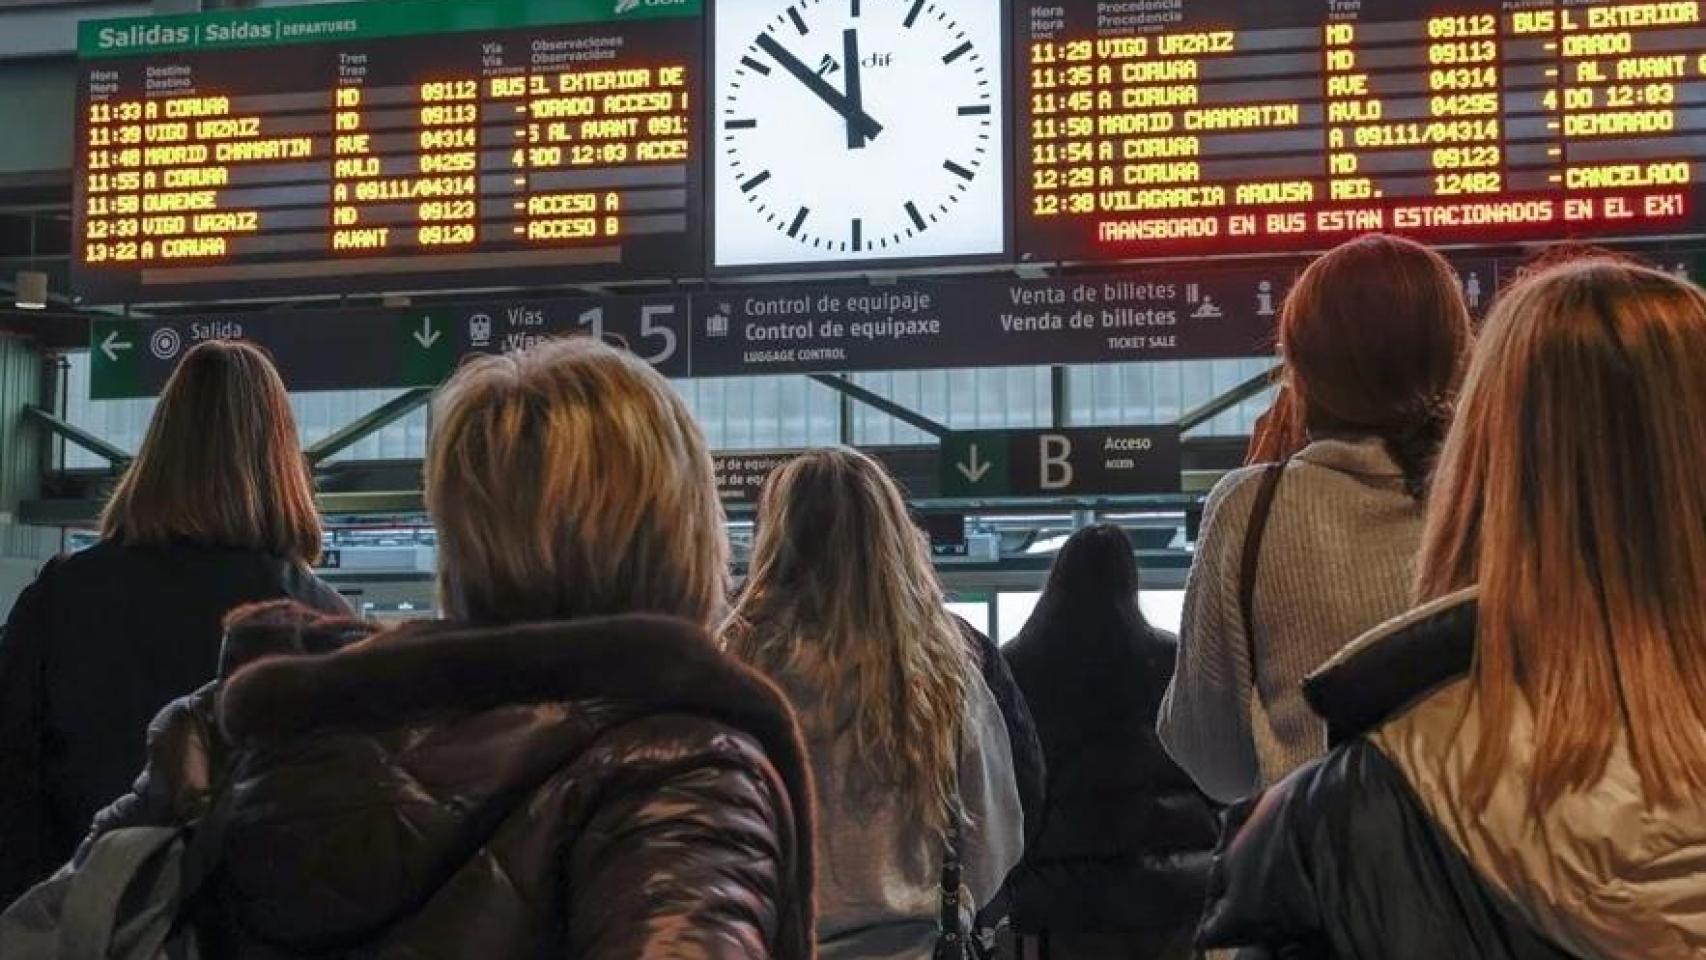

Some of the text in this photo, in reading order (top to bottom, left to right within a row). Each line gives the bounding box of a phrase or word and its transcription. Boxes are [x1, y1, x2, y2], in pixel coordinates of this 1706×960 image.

[1032, 6, 1064, 18] Hora
[1097, 0, 1183, 13] Procedencia
[1097, 11, 1183, 27] Procedencia
[98, 19, 357, 48] Salidas Saídas DEPARTURES
[1031, 40, 1093, 63] 11:29
[1096, 36, 1148, 59] VIGO
[1158, 30, 1234, 55] URZAIZ
[1326, 24, 1354, 45] MD
[1427, 14, 1496, 38] 09112
[1512, 10, 1555, 34] BUS
[1560, 9, 1578, 30] L
[1587, 1, 1699, 28] EXTERIOR
[1032, 19, 1064, 30] Hora
[338, 52, 367, 64] Tren
[531, 36, 624, 52] Observaciones
[339, 64, 366, 76] Tren
[1032, 65, 1093, 88] 11:35
[1097, 65, 1112, 84] A
[1326, 49, 1355, 71] MD
[1429, 40, 1496, 65] 09113
[90, 102, 142, 123] 11:33
[144, 101, 158, 119] A
[420, 80, 477, 102] 09112
[491, 76, 526, 97] BUS
[559, 68, 650, 93] EXTERIOR
[658, 66, 683, 86] DE
[1032, 90, 1093, 114] 11:45
[1098, 90, 1112, 110] A
[1328, 74, 1368, 96] AVE
[1429, 67, 1497, 90] 04314
[1576, 61, 1607, 82] AL
[1616, 55, 1686, 80] AVANT
[144, 122, 188, 142] VIGO
[196, 117, 260, 140] URZAIZ
[420, 103, 476, 125] 09113
[603, 91, 673, 115] ACCESO
[1098, 111, 1174, 135] MADRID
[1183, 104, 1299, 130] CHAMARTIN
[1431, 92, 1498, 117] 04295
[1543, 90, 1558, 111] 4
[1606, 82, 1674, 107] 12:03
[144, 144, 208, 165] MADRID
[215, 138, 312, 162] CHAMARTIN
[335, 134, 370, 154] AVE
[420, 128, 476, 150] 04314
[548, 122, 572, 142] AL
[581, 117, 639, 140] AVANT
[648, 115, 687, 136] 091
[1033, 142, 1094, 164] 11:54
[1098, 140, 1113, 161] A
[1329, 127, 1344, 148] A
[1354, 119, 1498, 147] 09111/04314
[1564, 109, 1674, 136] DEMORADO
[88, 171, 140, 192] 11:55
[144, 171, 157, 189] A
[420, 152, 476, 173] 04295
[511, 148, 525, 167] 4
[571, 142, 627, 165] 12:03
[1033, 167, 1094, 190] 12:29
[1099, 165, 1114, 186] A
[1330, 153, 1357, 174] MD
[1432, 146, 1500, 169] 09123
[142, 190, 217, 213] OURENSE
[334, 183, 347, 202] A
[355, 175, 476, 200] 09111/04314
[1099, 186, 1226, 211] VILAGARCIA
[1235, 181, 1313, 205] AROUSA
[1330, 178, 1382, 200] REG.
[1566, 162, 1690, 189] CANCELADO
[86, 218, 138, 239] 12:33
[142, 215, 186, 235] VIGO
[192, 211, 258, 233] URZAIZ
[418, 200, 475, 221] 09123
[528, 194, 596, 215] ACCESO
[605, 192, 619, 211] A
[1228, 215, 1255, 235] EN
[1266, 213, 1306, 233] BUS
[1317, 209, 1382, 231] ESTAN
[1394, 200, 1552, 227] ESTACIONADOS
[1564, 198, 1593, 219] EN
[1604, 198, 1633, 217] EL
[86, 242, 138, 262] 13:22
[140, 240, 154, 259] A
[333, 227, 389, 249] AVANT
[418, 223, 475, 245] 09120
[528, 217, 596, 239] ACCESO
[605, 217, 619, 235] B
[744, 289, 931, 317] Control de equipaje
[1010, 280, 1176, 306] Venta de billetes
[191, 319, 243, 340] Salida
[508, 306, 543, 326] Vías
[744, 315, 941, 340] Control de equipaxe
[1000, 308, 1176, 332] Venda de billetes
[640, 304, 677, 365] 5
[1108, 335, 1176, 349] TICKET SALE
[744, 348, 846, 362] LUGGAGE CONTROL
[1104, 435, 1153, 451] Acceso
[1039, 434, 1074, 489] B
